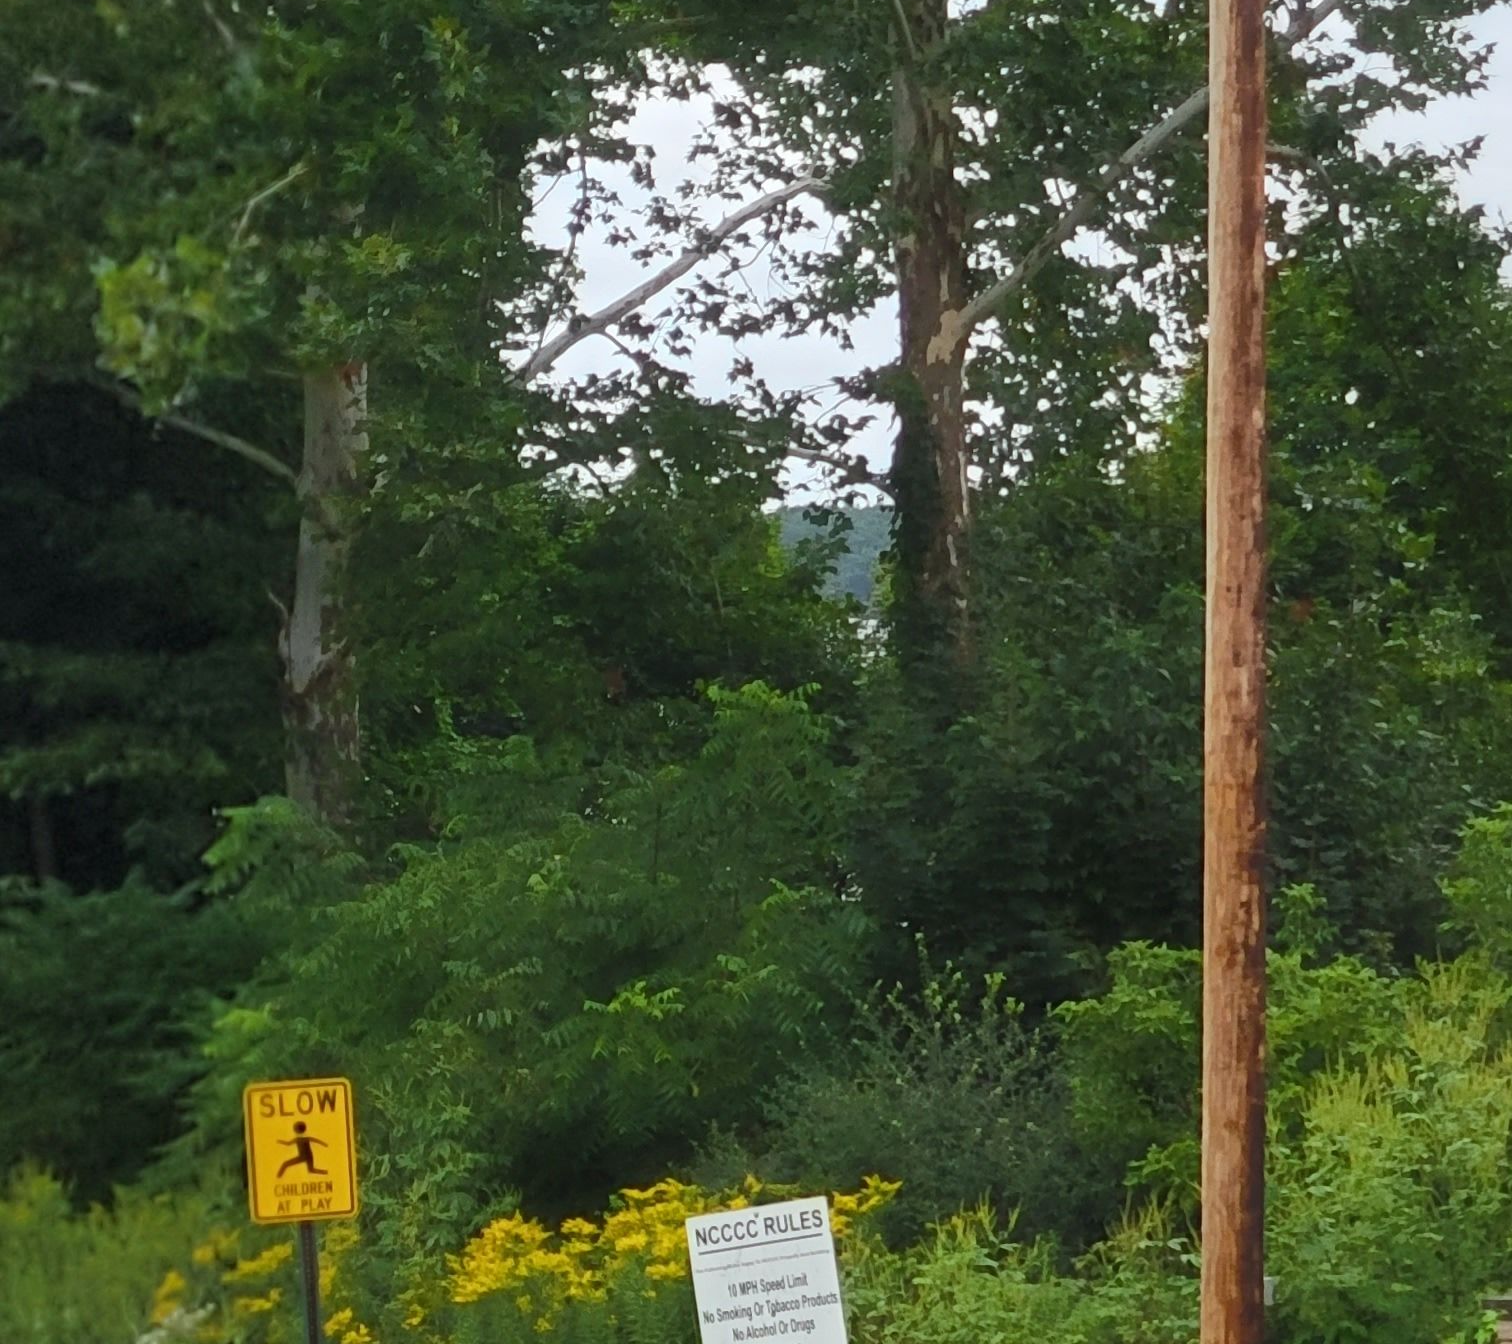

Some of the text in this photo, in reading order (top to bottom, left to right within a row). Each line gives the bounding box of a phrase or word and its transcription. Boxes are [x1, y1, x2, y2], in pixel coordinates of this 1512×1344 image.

[260, 1088, 337, 1118] SLOW
[274, 1181, 333, 1197] CHILDREN
[276, 1197, 333, 1214] AT PLAY
[695, 1209, 823, 1247] NCCCC RULES
[728, 1272, 808, 1297] 10 MPH Speed Limit
[702, 1292, 838, 1324] No Smoking Or Tobacco Products
[732, 1318, 815, 1342] No Alcohol Or Drugs
